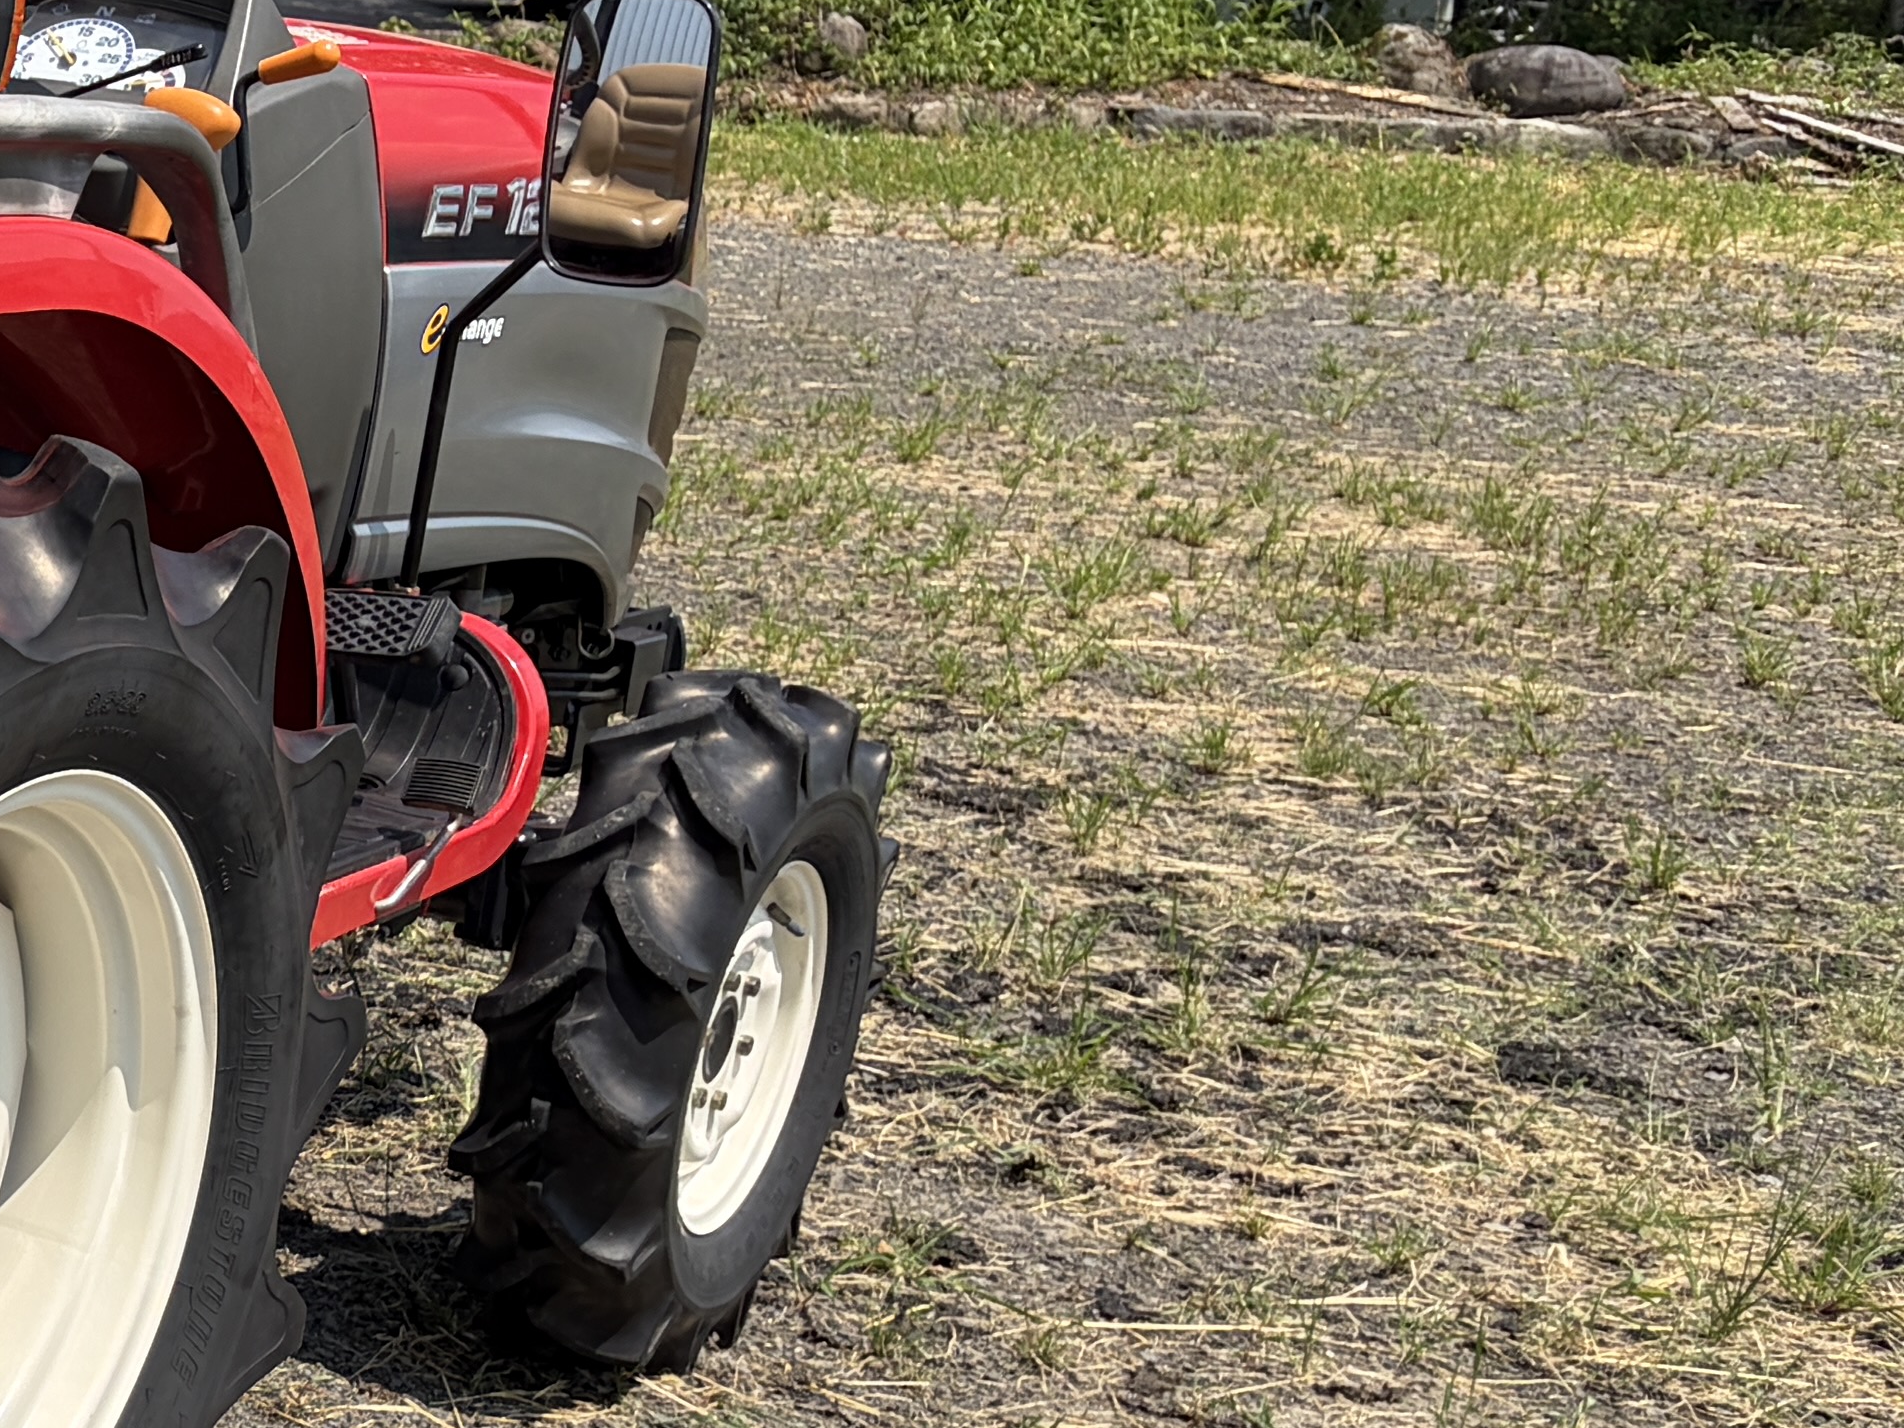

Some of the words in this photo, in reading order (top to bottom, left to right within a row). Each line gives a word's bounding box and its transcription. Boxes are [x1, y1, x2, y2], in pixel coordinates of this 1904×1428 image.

[78, 26, 96, 38] 15
[95, 36, 120, 48] 20
[98, 53, 122, 65] 25
[421, 183, 499, 238] EF
[170, 992, 283, 1389] BRIDGESTONE
